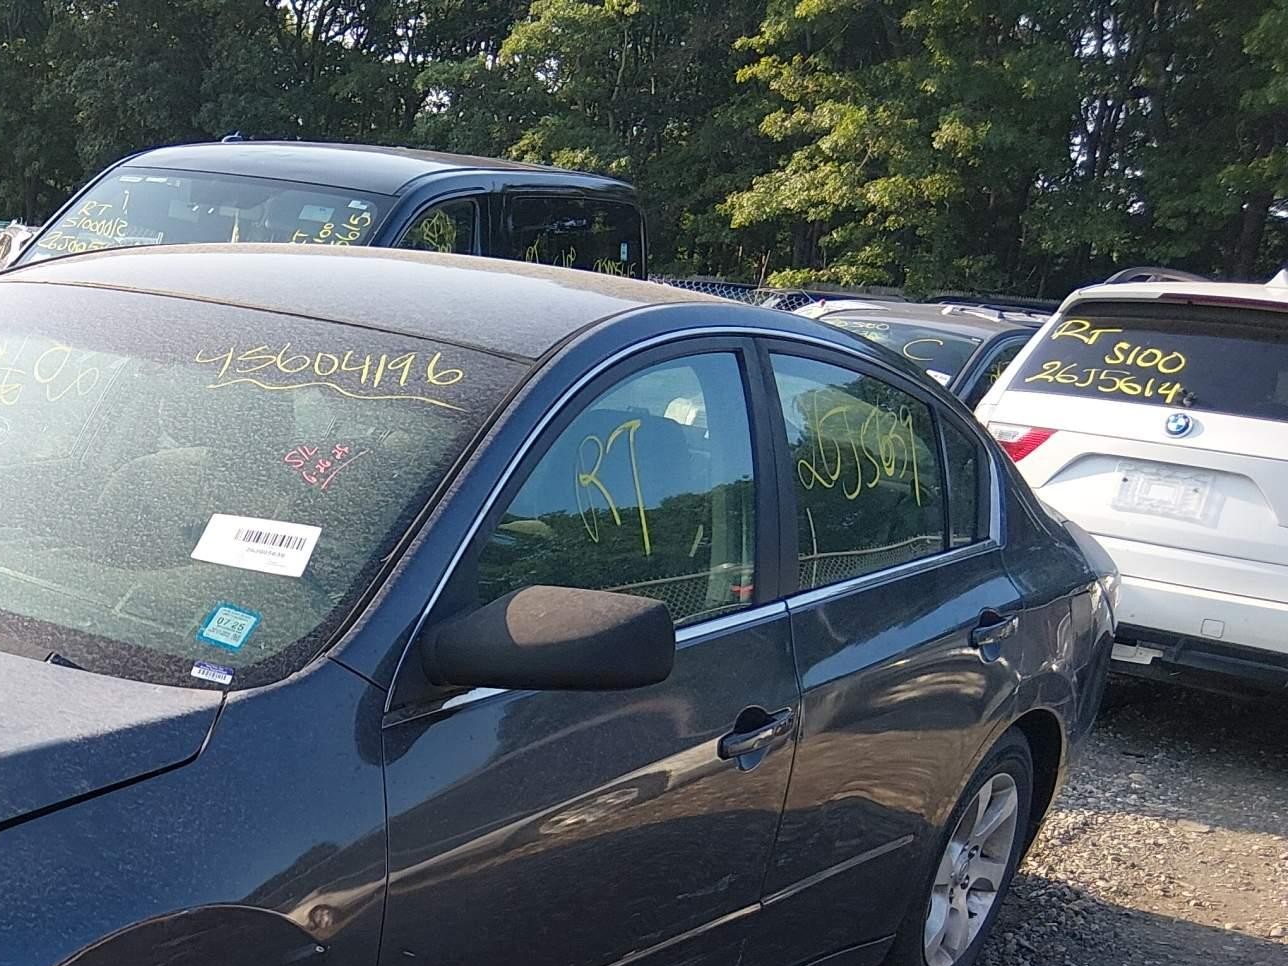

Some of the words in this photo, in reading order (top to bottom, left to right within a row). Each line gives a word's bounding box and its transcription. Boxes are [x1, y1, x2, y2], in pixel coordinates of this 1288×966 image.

[1050, 319, 1122, 345] RT
[195, 342, 464, 388] 45604196
[1104, 341, 1187, 375] S100
[1025, 360, 1184, 404] 26J5614
